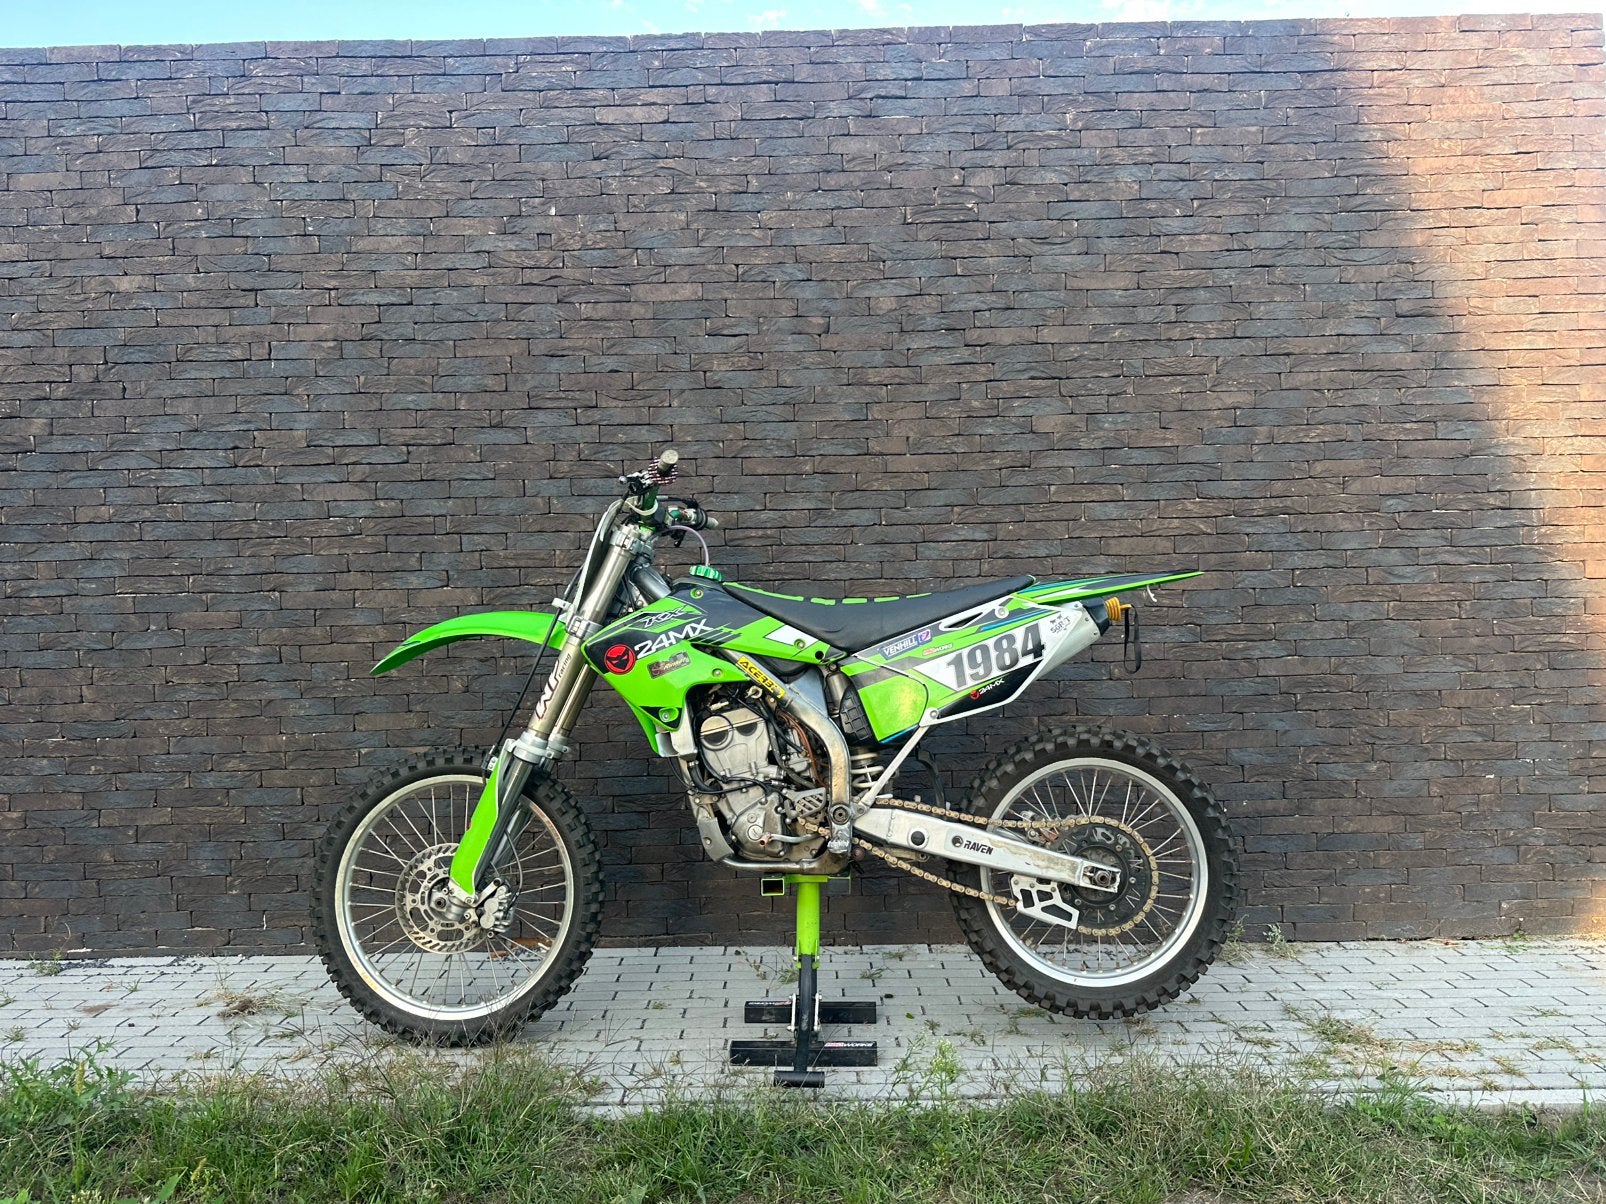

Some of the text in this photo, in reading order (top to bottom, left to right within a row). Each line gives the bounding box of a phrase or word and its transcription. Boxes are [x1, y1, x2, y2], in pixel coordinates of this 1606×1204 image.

[633, 619, 714, 659] 24MX
[882, 635, 919, 656] VENHILL
[558, 653, 572, 678] racing
[946, 622, 1045, 690] 1984
[979, 677, 1005, 695] 24MX
[963, 839, 995, 855] RAVEN
